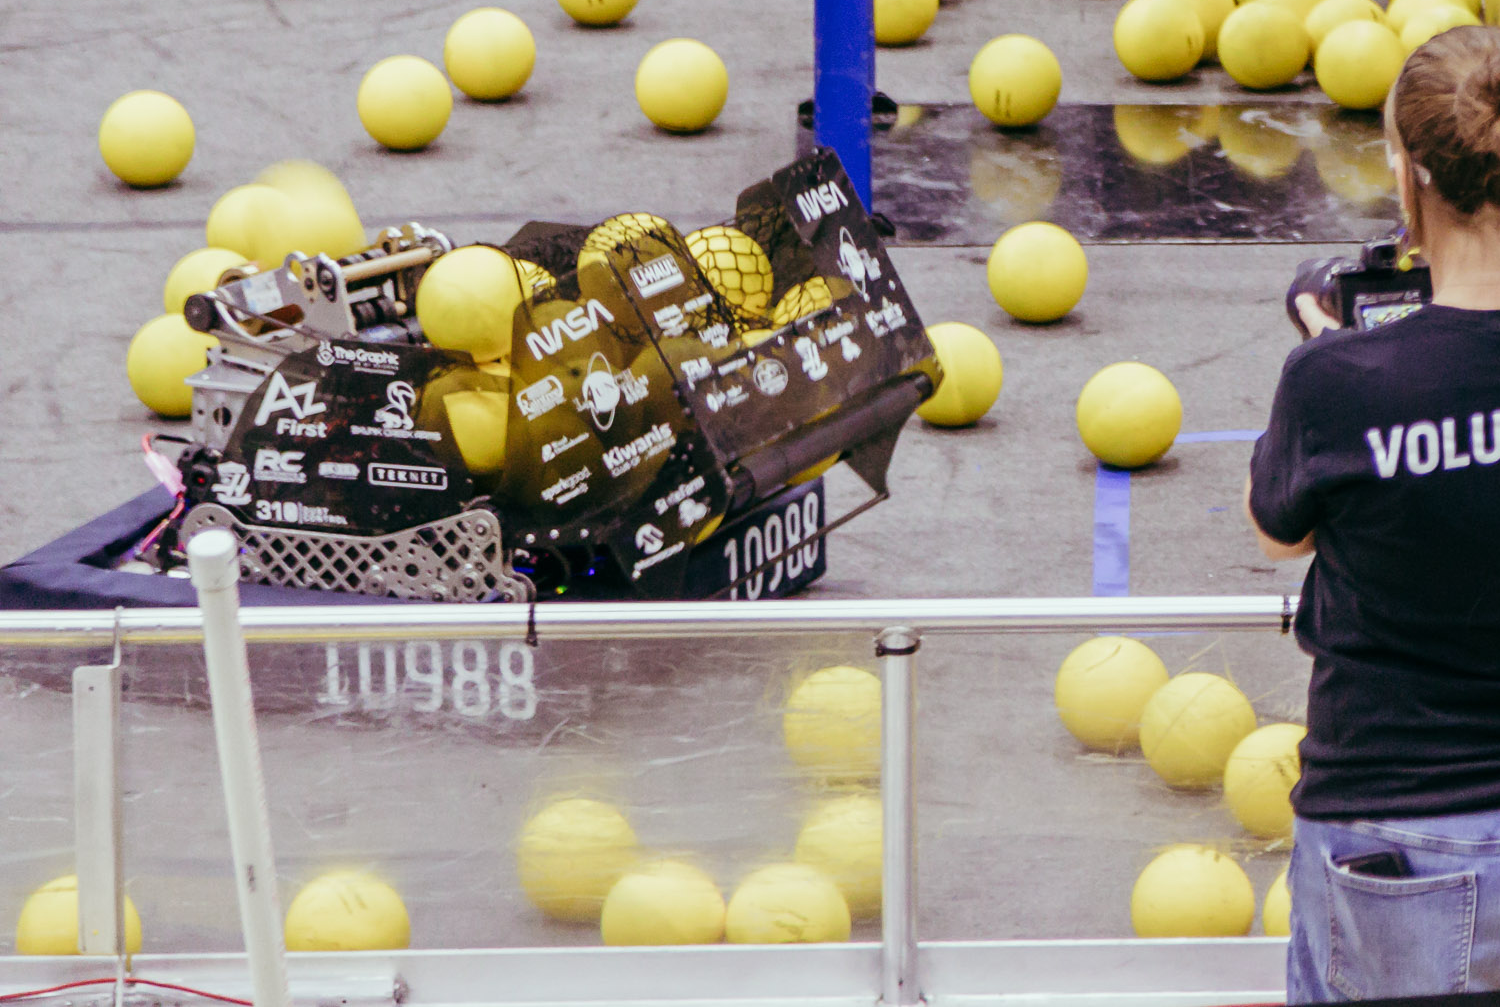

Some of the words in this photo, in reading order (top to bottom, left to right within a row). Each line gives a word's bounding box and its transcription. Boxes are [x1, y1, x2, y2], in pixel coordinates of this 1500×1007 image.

[796, 180, 849, 223] NASA
[525, 298, 615, 361] NASA
[254, 371, 327, 426] AZ
[276, 417, 328, 439] First
[602, 423, 673, 471] Kiwanis
[254, 449, 306, 475] RC
[376, 467, 440, 484] TEKNET
[255, 499, 300, 524] 310
[724, 491, 820, 602] 10988
